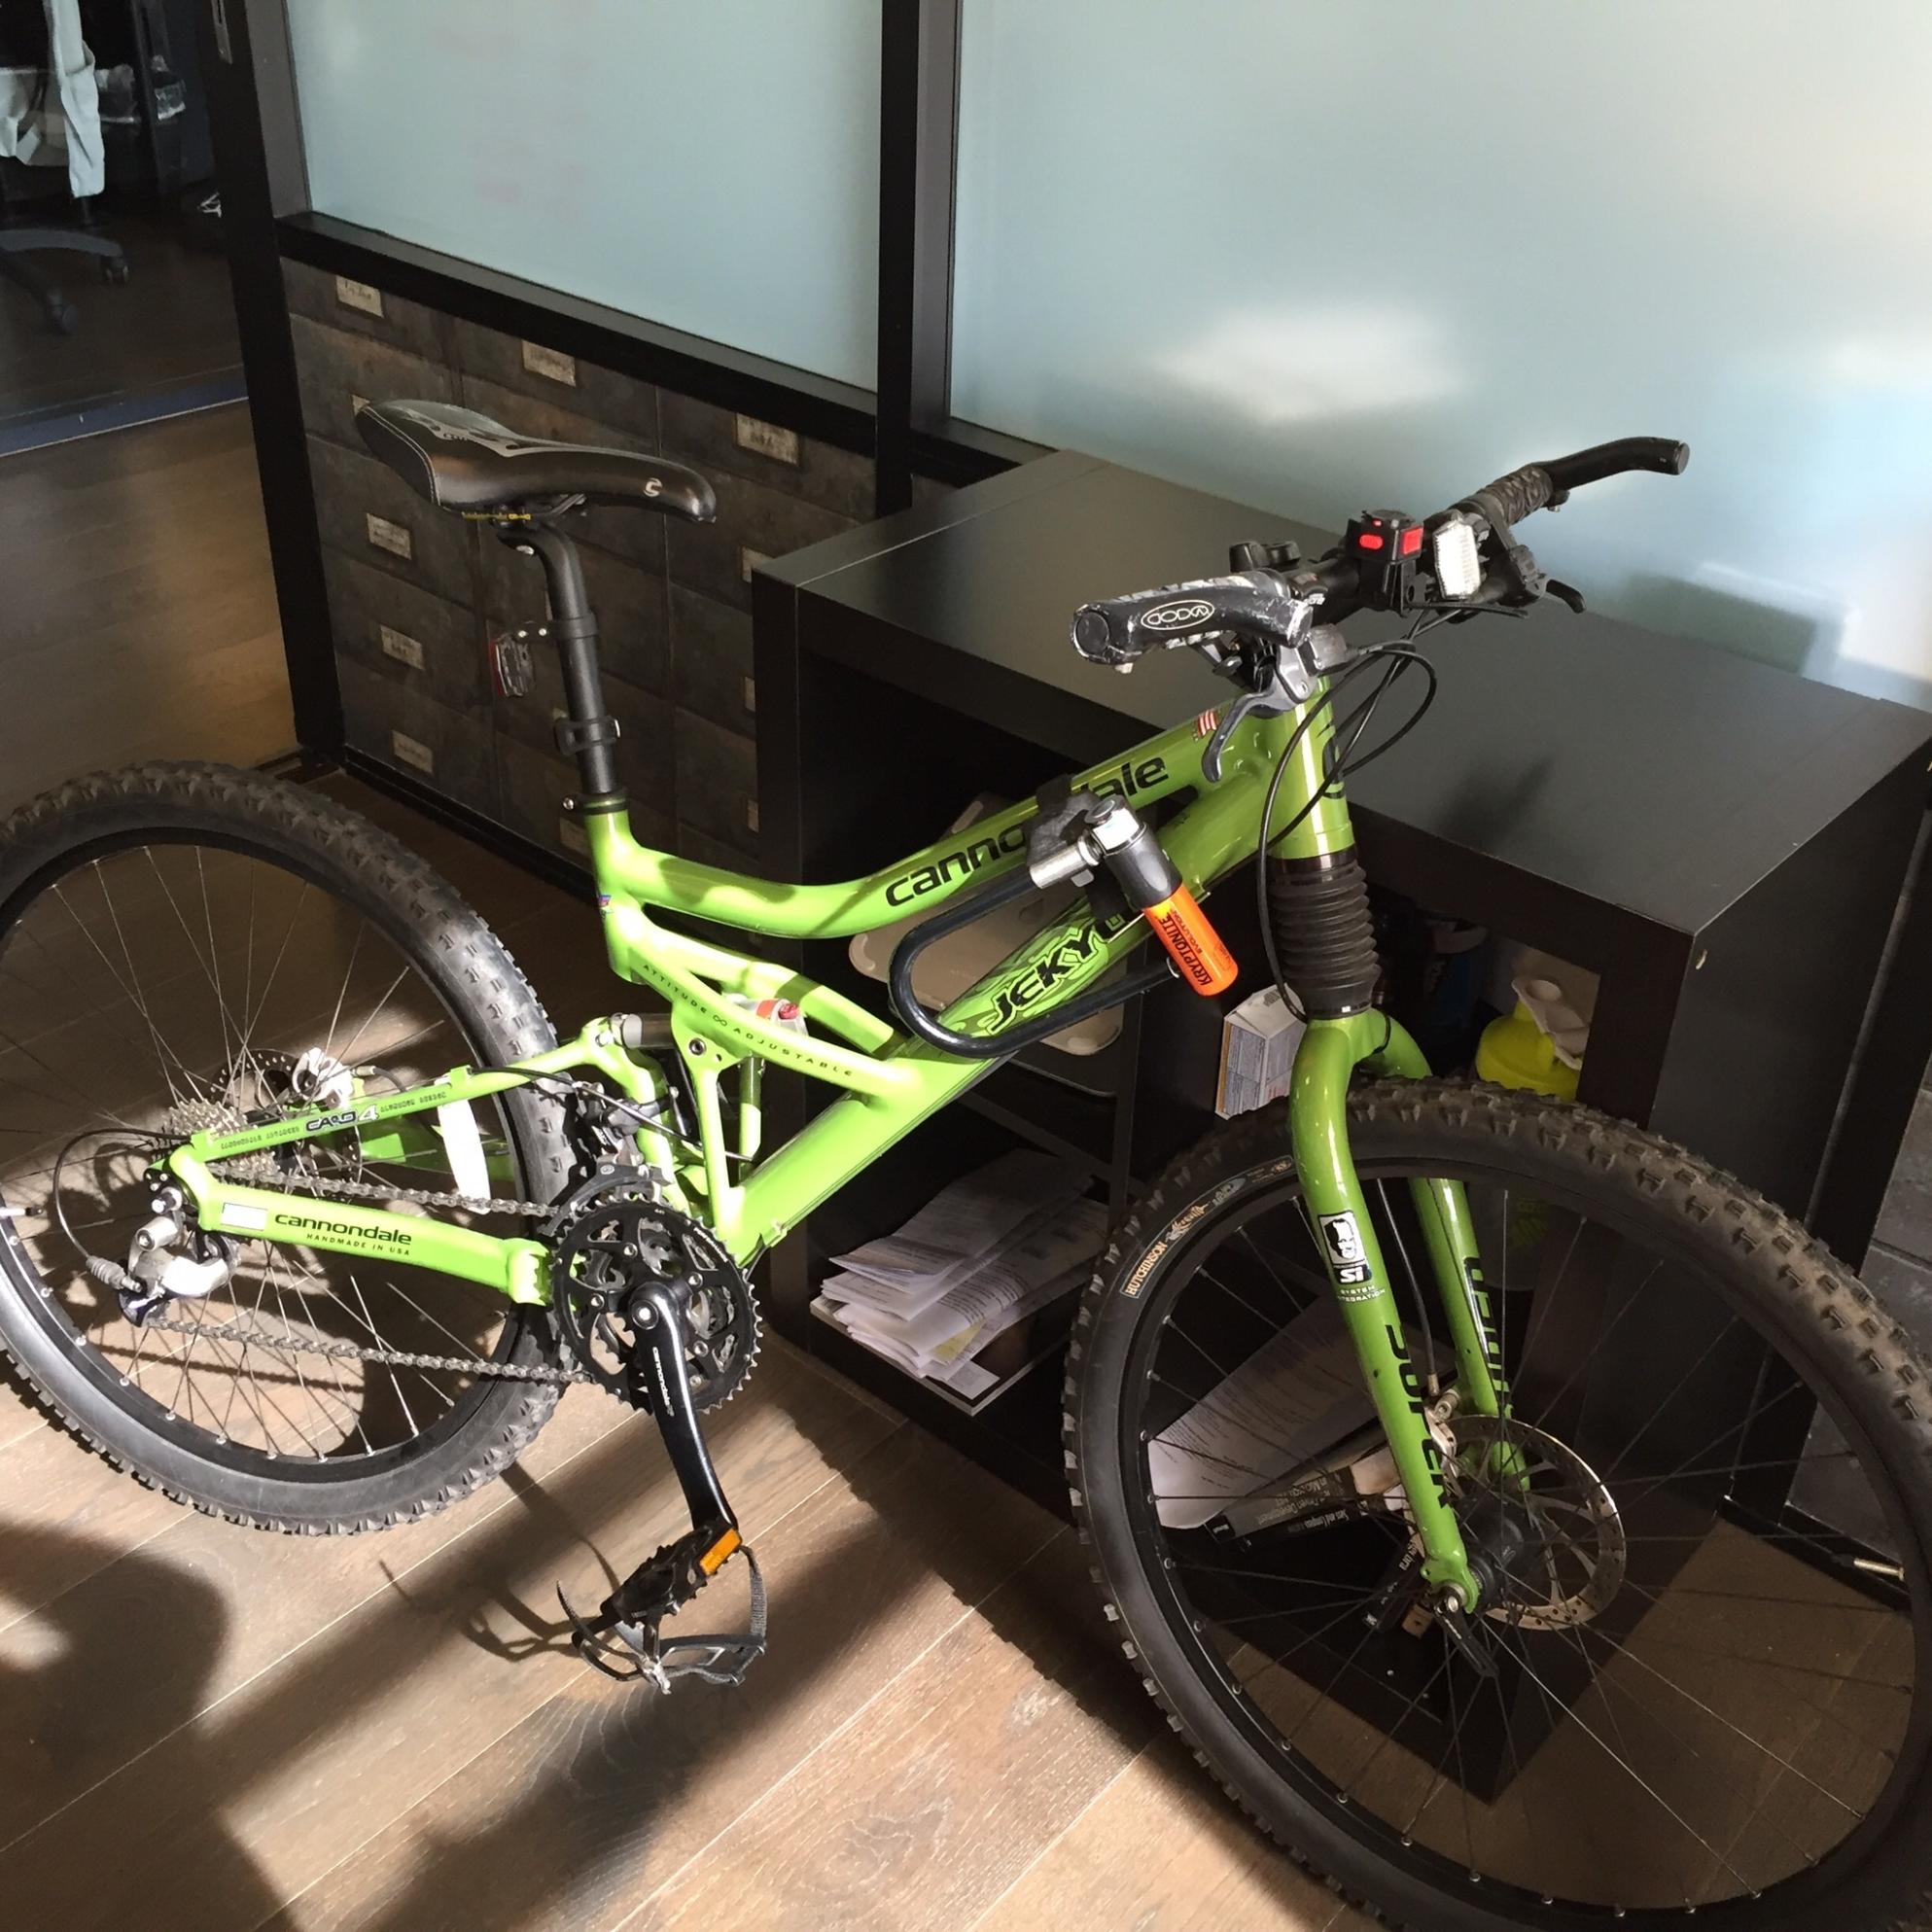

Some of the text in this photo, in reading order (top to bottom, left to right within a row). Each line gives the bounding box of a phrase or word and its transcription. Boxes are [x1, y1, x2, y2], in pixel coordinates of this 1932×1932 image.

[885, 756, 1170, 907] cannoale
[1155, 913, 1213, 985] KRYPTONITE
[642, 964, 853, 1076] ATTITUDE ADJUSTABLE
[274, 1214, 412, 1246] cannondale
[306, 1233, 367, 1249] HANDMADE
[390, 1247, 409, 1256] USA
[1125, 1241, 1168, 1295] HUTCHINSON
